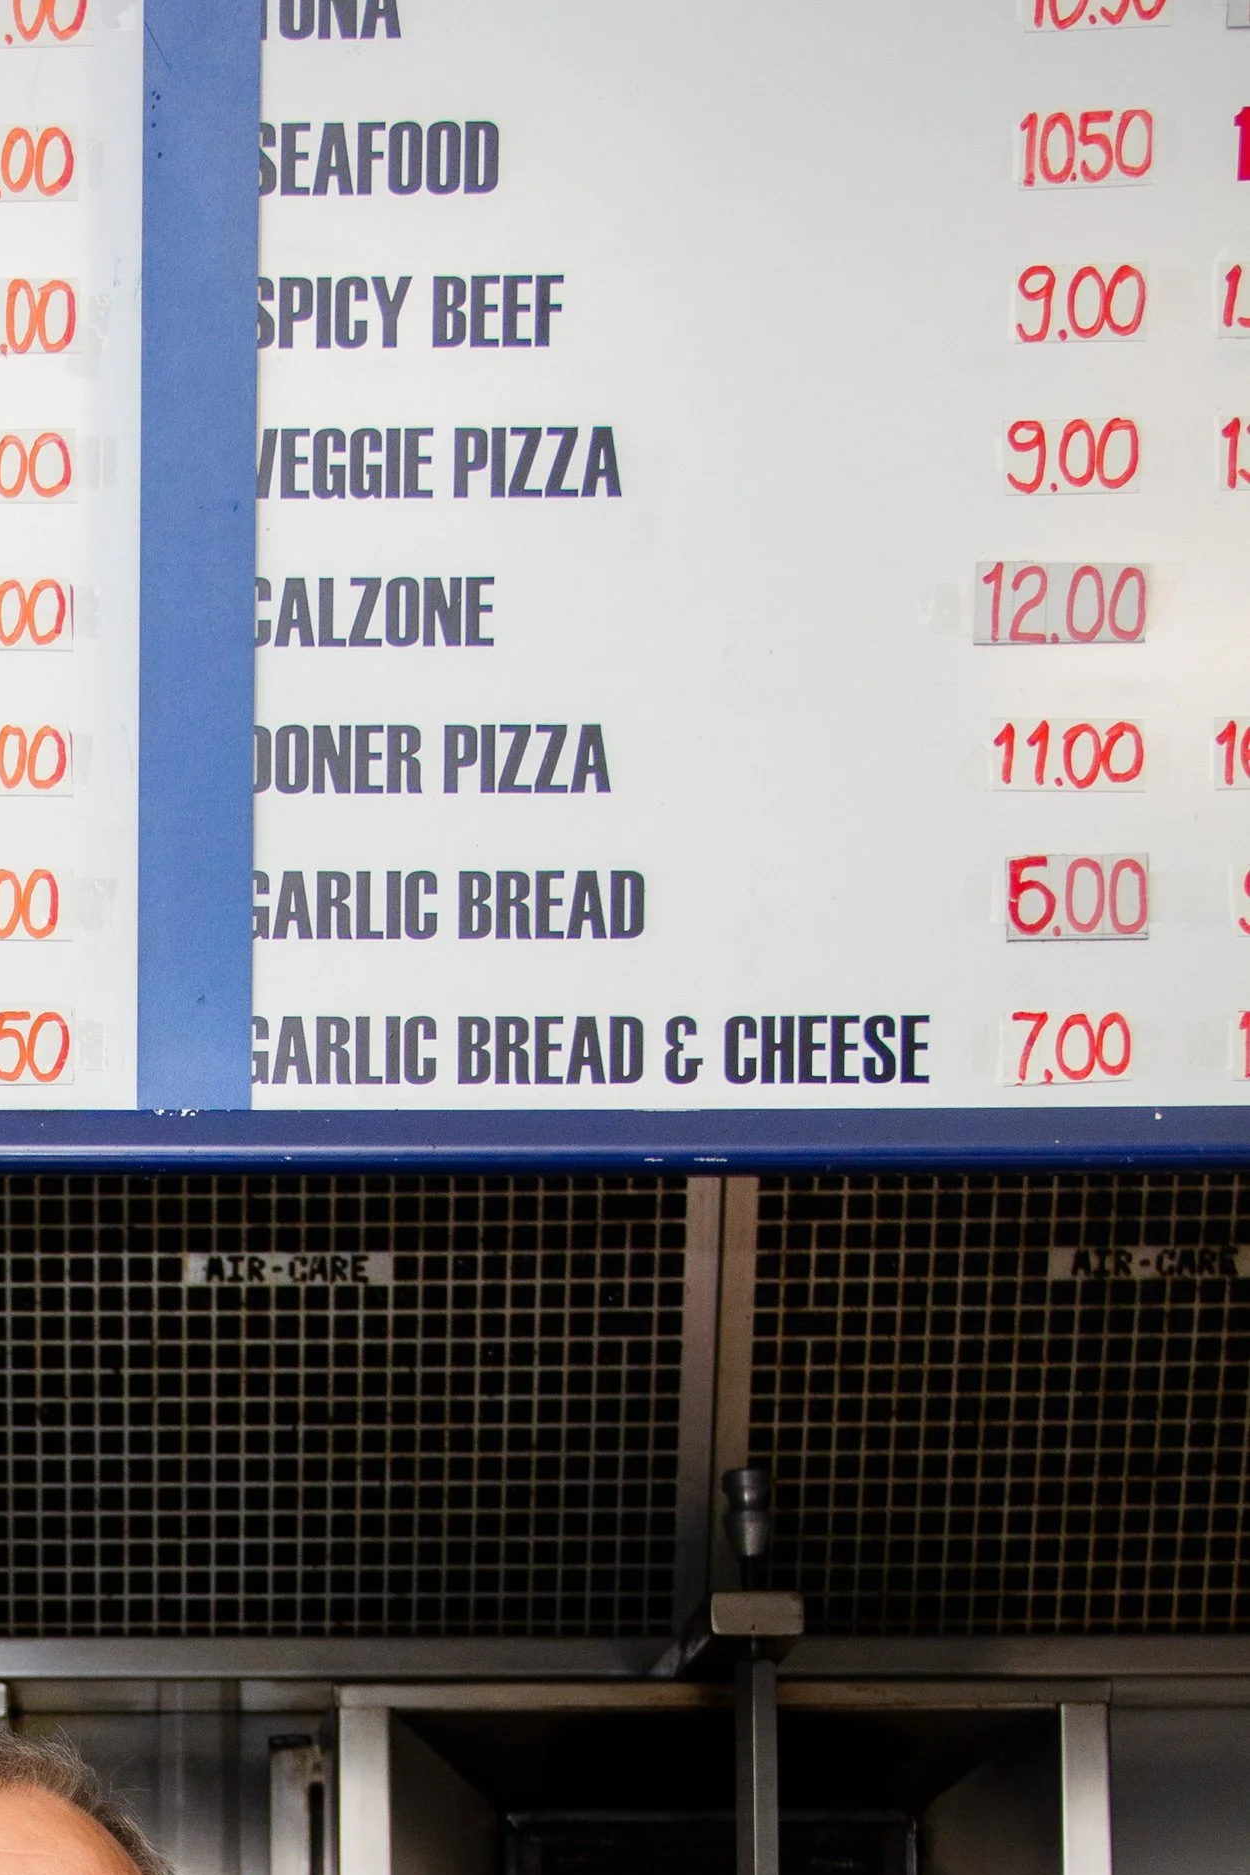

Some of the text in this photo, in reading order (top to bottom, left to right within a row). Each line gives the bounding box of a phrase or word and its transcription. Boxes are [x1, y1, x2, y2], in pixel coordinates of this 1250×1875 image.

[259, 121, 499, 195] SEAFOOD
[1020, 109, 1153, 187] 10.50
[258, 275, 564, 349] SPICY BEEF
[1016, 264, 1146, 343] 9.00
[454, 426, 621, 498] PIZZA
[1007, 417, 1140, 494] 9.00
[983, 562, 1146, 643] 12.00
[444, 724, 610, 793] PIZZA
[994, 720, 1144, 788] 11.00
[459, 871, 645, 940] BREAD
[458, 1016, 643, 1085] BREAD
[665, 1016, 703, 1085] &
[725, 1015, 930, 1084] CHEESE
[1012, 1011, 1132, 1085] 7.00
[206, 1255, 370, 1284] AIR-CARE
